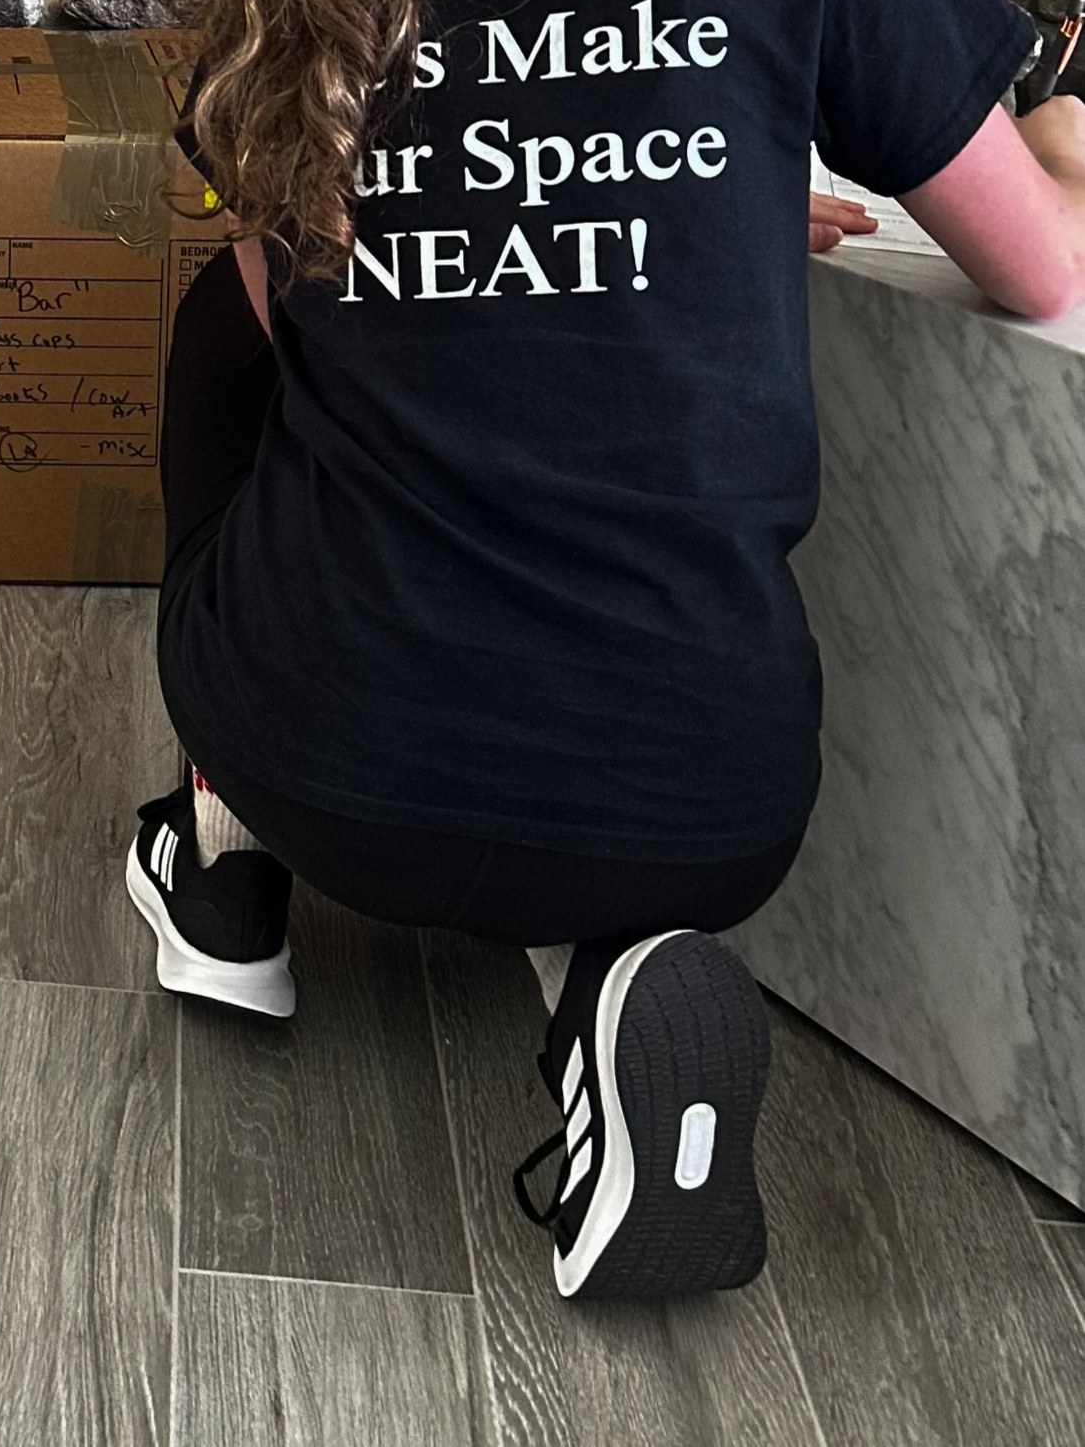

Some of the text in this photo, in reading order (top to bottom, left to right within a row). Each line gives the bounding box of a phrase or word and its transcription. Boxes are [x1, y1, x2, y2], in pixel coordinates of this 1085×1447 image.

[353, 118, 727, 207] ur Space
[180, 246, 224, 257] BEDRO
[339, 218, 649, 303] NEAT!
